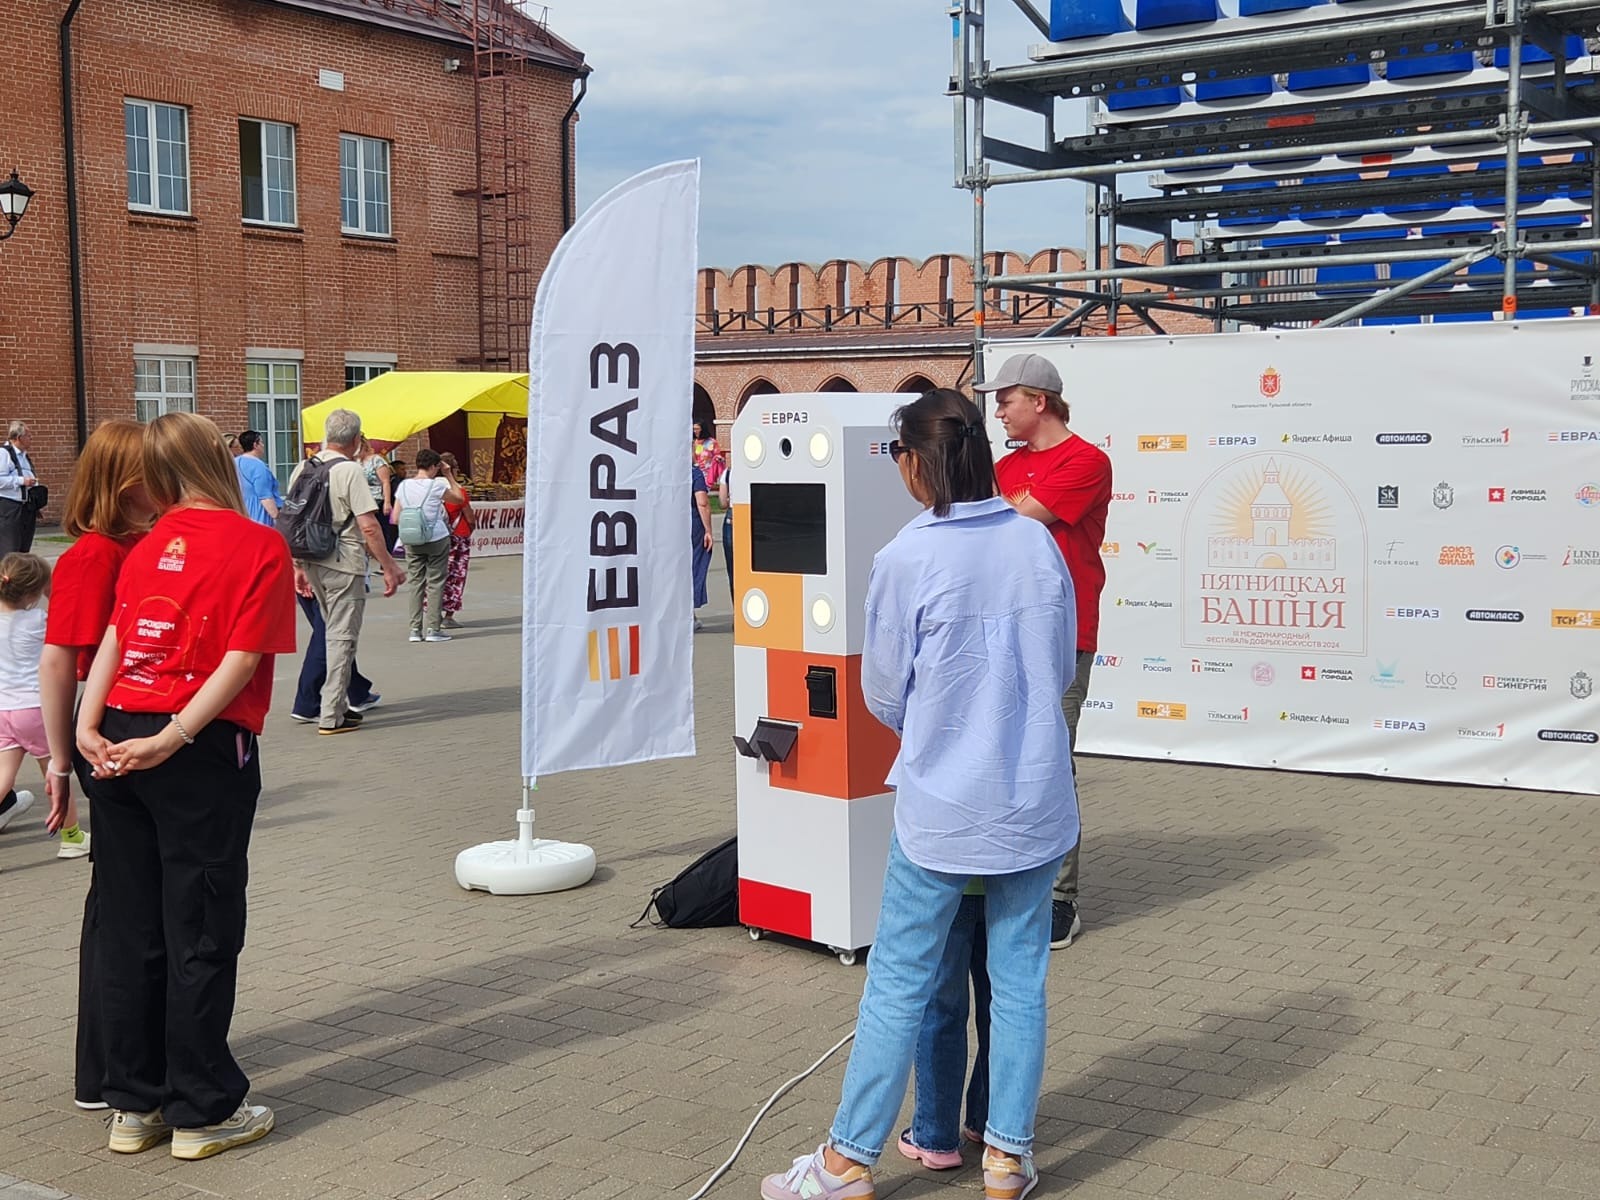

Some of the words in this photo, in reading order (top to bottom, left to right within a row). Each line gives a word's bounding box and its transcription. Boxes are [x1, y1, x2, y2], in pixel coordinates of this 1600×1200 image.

[772, 412, 808, 424] ЕВРАЗ
[1292, 434, 1321, 443] Яндекс
[1322, 434, 1352, 443] Афиша
[1379, 434, 1428, 443] АВТОКЛАСС
[1561, 431, 1600, 441] ЕВРА
[1218, 437, 1257, 446] ЕВРАЗ
[587, 342, 640, 612] ЕВРАЗ
[1438, 558, 1475, 566] ФИЛЬМ
[1200, 573, 1346, 598] ПЯТНИЦКАЯ
[1125, 599, 1147, 608] Яндекс
[1149, 600, 1173, 608] Афиша
[1200, 596, 1347, 629] БАШНЯ
[1397, 608, 1440, 618] ЕВРАЗ
[1469, 612, 1520, 620] АВТОКЛАСС
[1240, 631, 1310, 640] МЕЖДУНАРОДНЫЙ
[1206, 637, 1249, 645] ФЕСТИВАЛЬ
[1249, 638, 1281, 646] ДОБРЫХ
[1281, 639, 1321, 648] ИСКУССТВ
[1322, 641, 1340, 649] 2024
[1143, 664, 1171, 672] Россия
[1496, 682, 1547, 691] СИНЕРГИЯ
[1290, 713, 1319, 722] Яндекс
[1320, 715, 1350, 724] Афиша
[1384, 720, 1426, 731] ЕВРАЗ
[1541, 731, 1595, 741] АВТОКЛАСС
